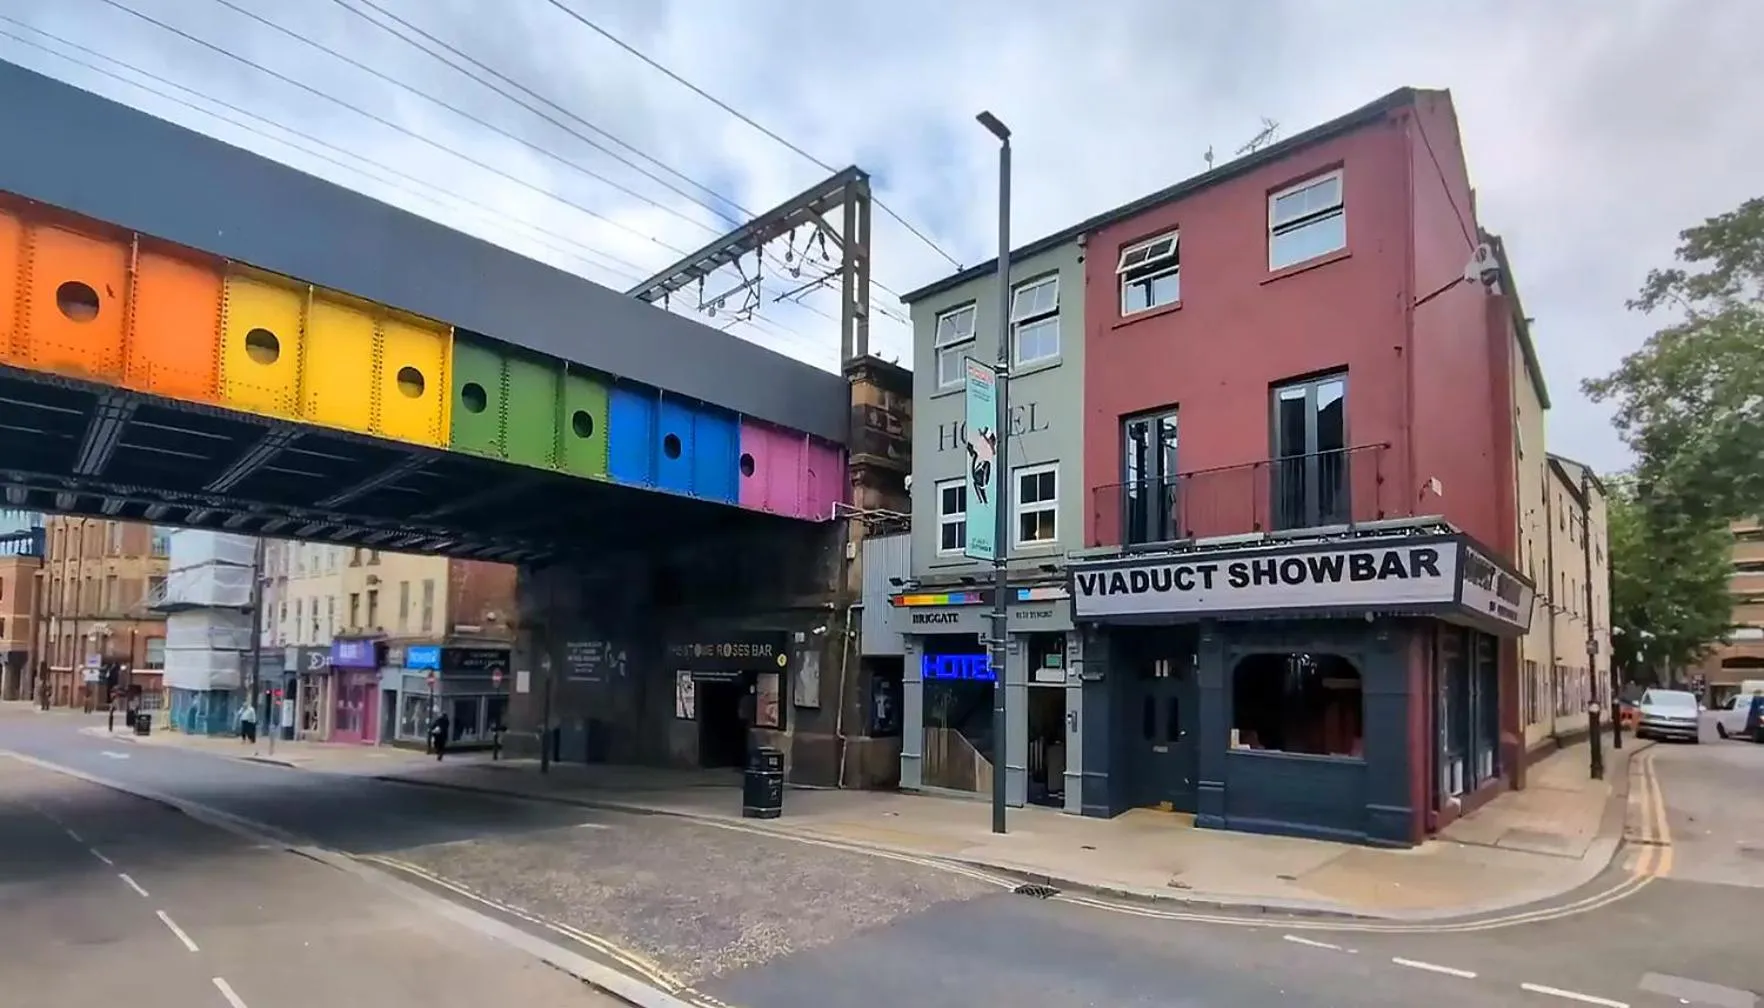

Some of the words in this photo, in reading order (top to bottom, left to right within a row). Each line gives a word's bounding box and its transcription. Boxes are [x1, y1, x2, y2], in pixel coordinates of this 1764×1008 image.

[938, 402, 1050, 452] HEL
[1077, 565, 1218, 596] VIADUCT
[1228, 548, 1441, 588] SHOWBAR
[912, 613, 959, 624] BRIGGATE
[716, 643, 750, 657] ROSES
[751, 644, 772, 657] BAR
